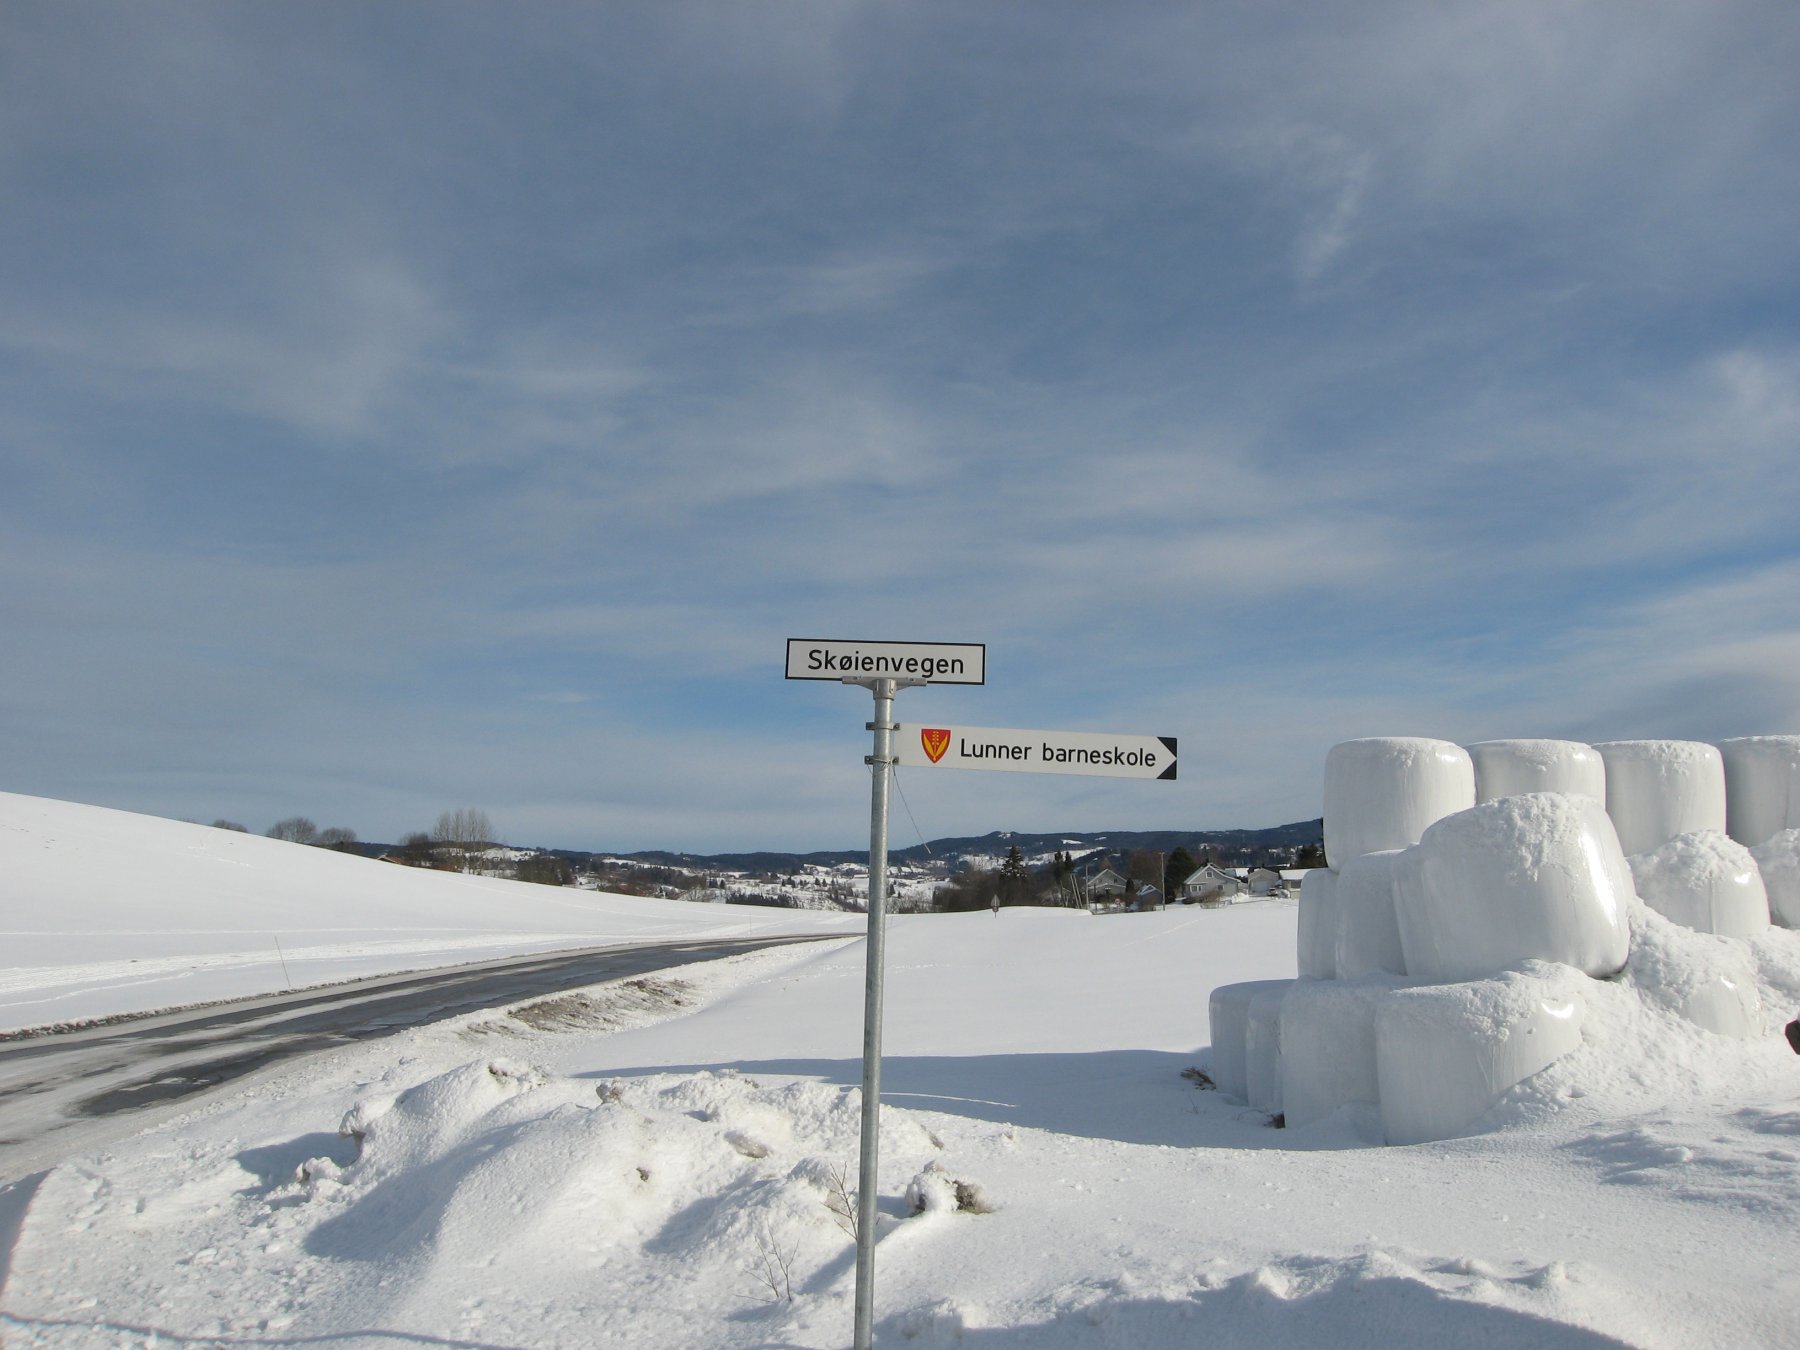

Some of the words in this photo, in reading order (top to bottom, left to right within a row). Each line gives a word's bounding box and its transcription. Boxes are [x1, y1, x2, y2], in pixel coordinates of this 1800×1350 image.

[808, 649, 964, 678] Skøienvegen
[960, 738, 1032, 760] Lunner
[1042, 742, 1156, 767] barneskole
